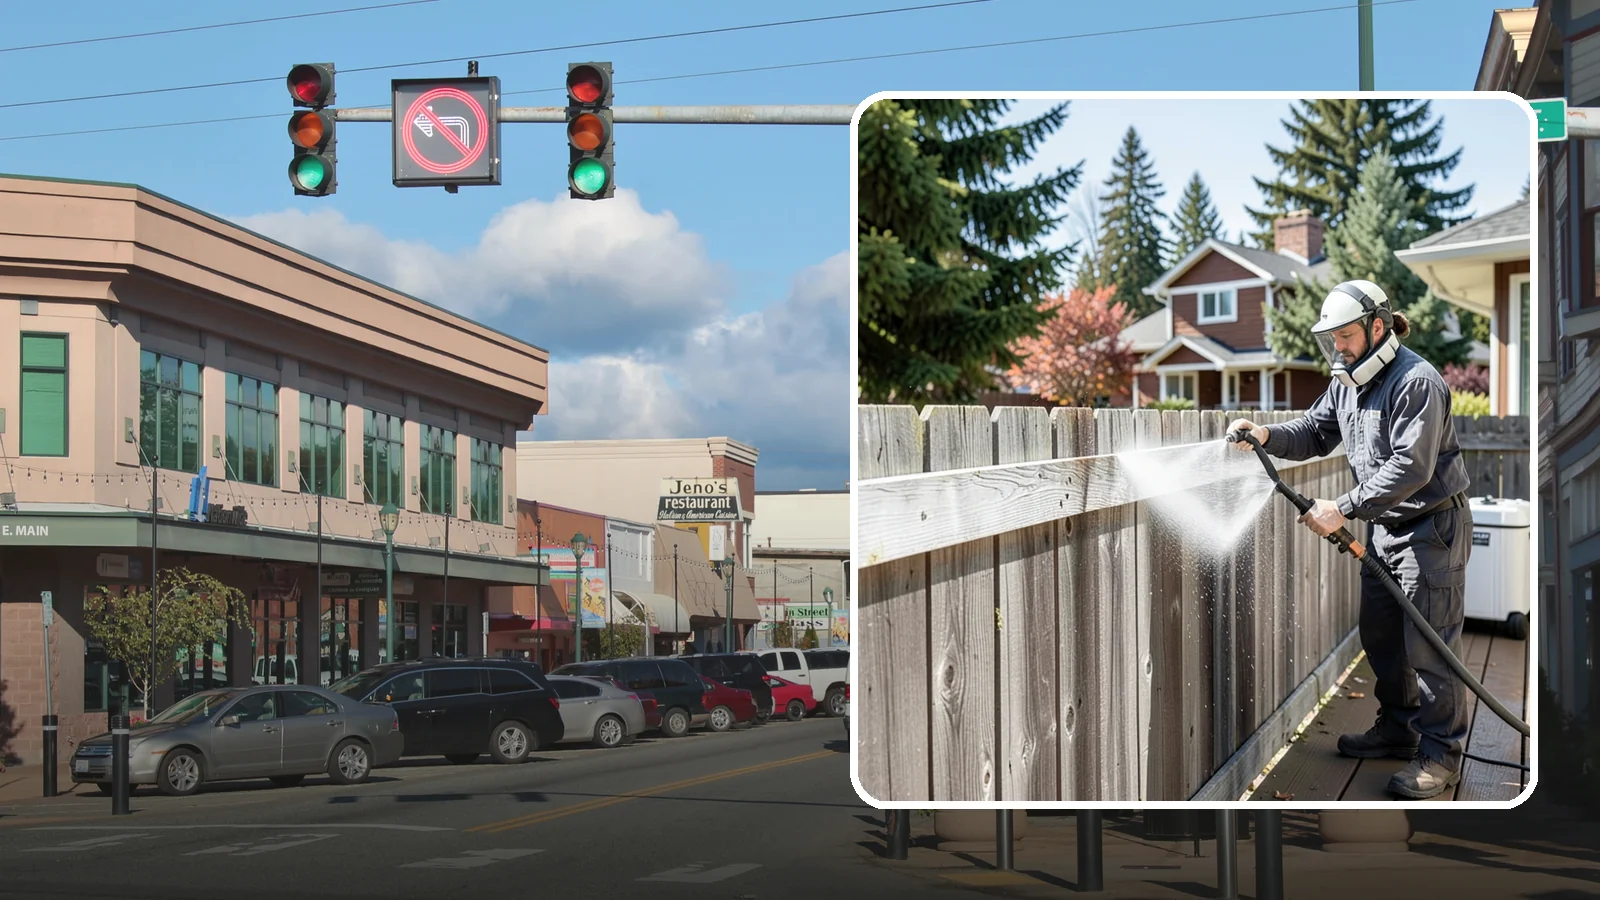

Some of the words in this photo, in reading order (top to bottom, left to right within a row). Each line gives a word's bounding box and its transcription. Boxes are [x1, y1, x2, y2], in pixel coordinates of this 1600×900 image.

[670, 480, 727, 494] Jeno's
[665, 496, 731, 509] restaurant
[686, 510, 714, 519] American
[715, 509, 737, 519] Cuisine
[2, 525, 13, 536] E.
[15, 525, 49, 536] MAIN
[797, 607, 828, 617] Street
